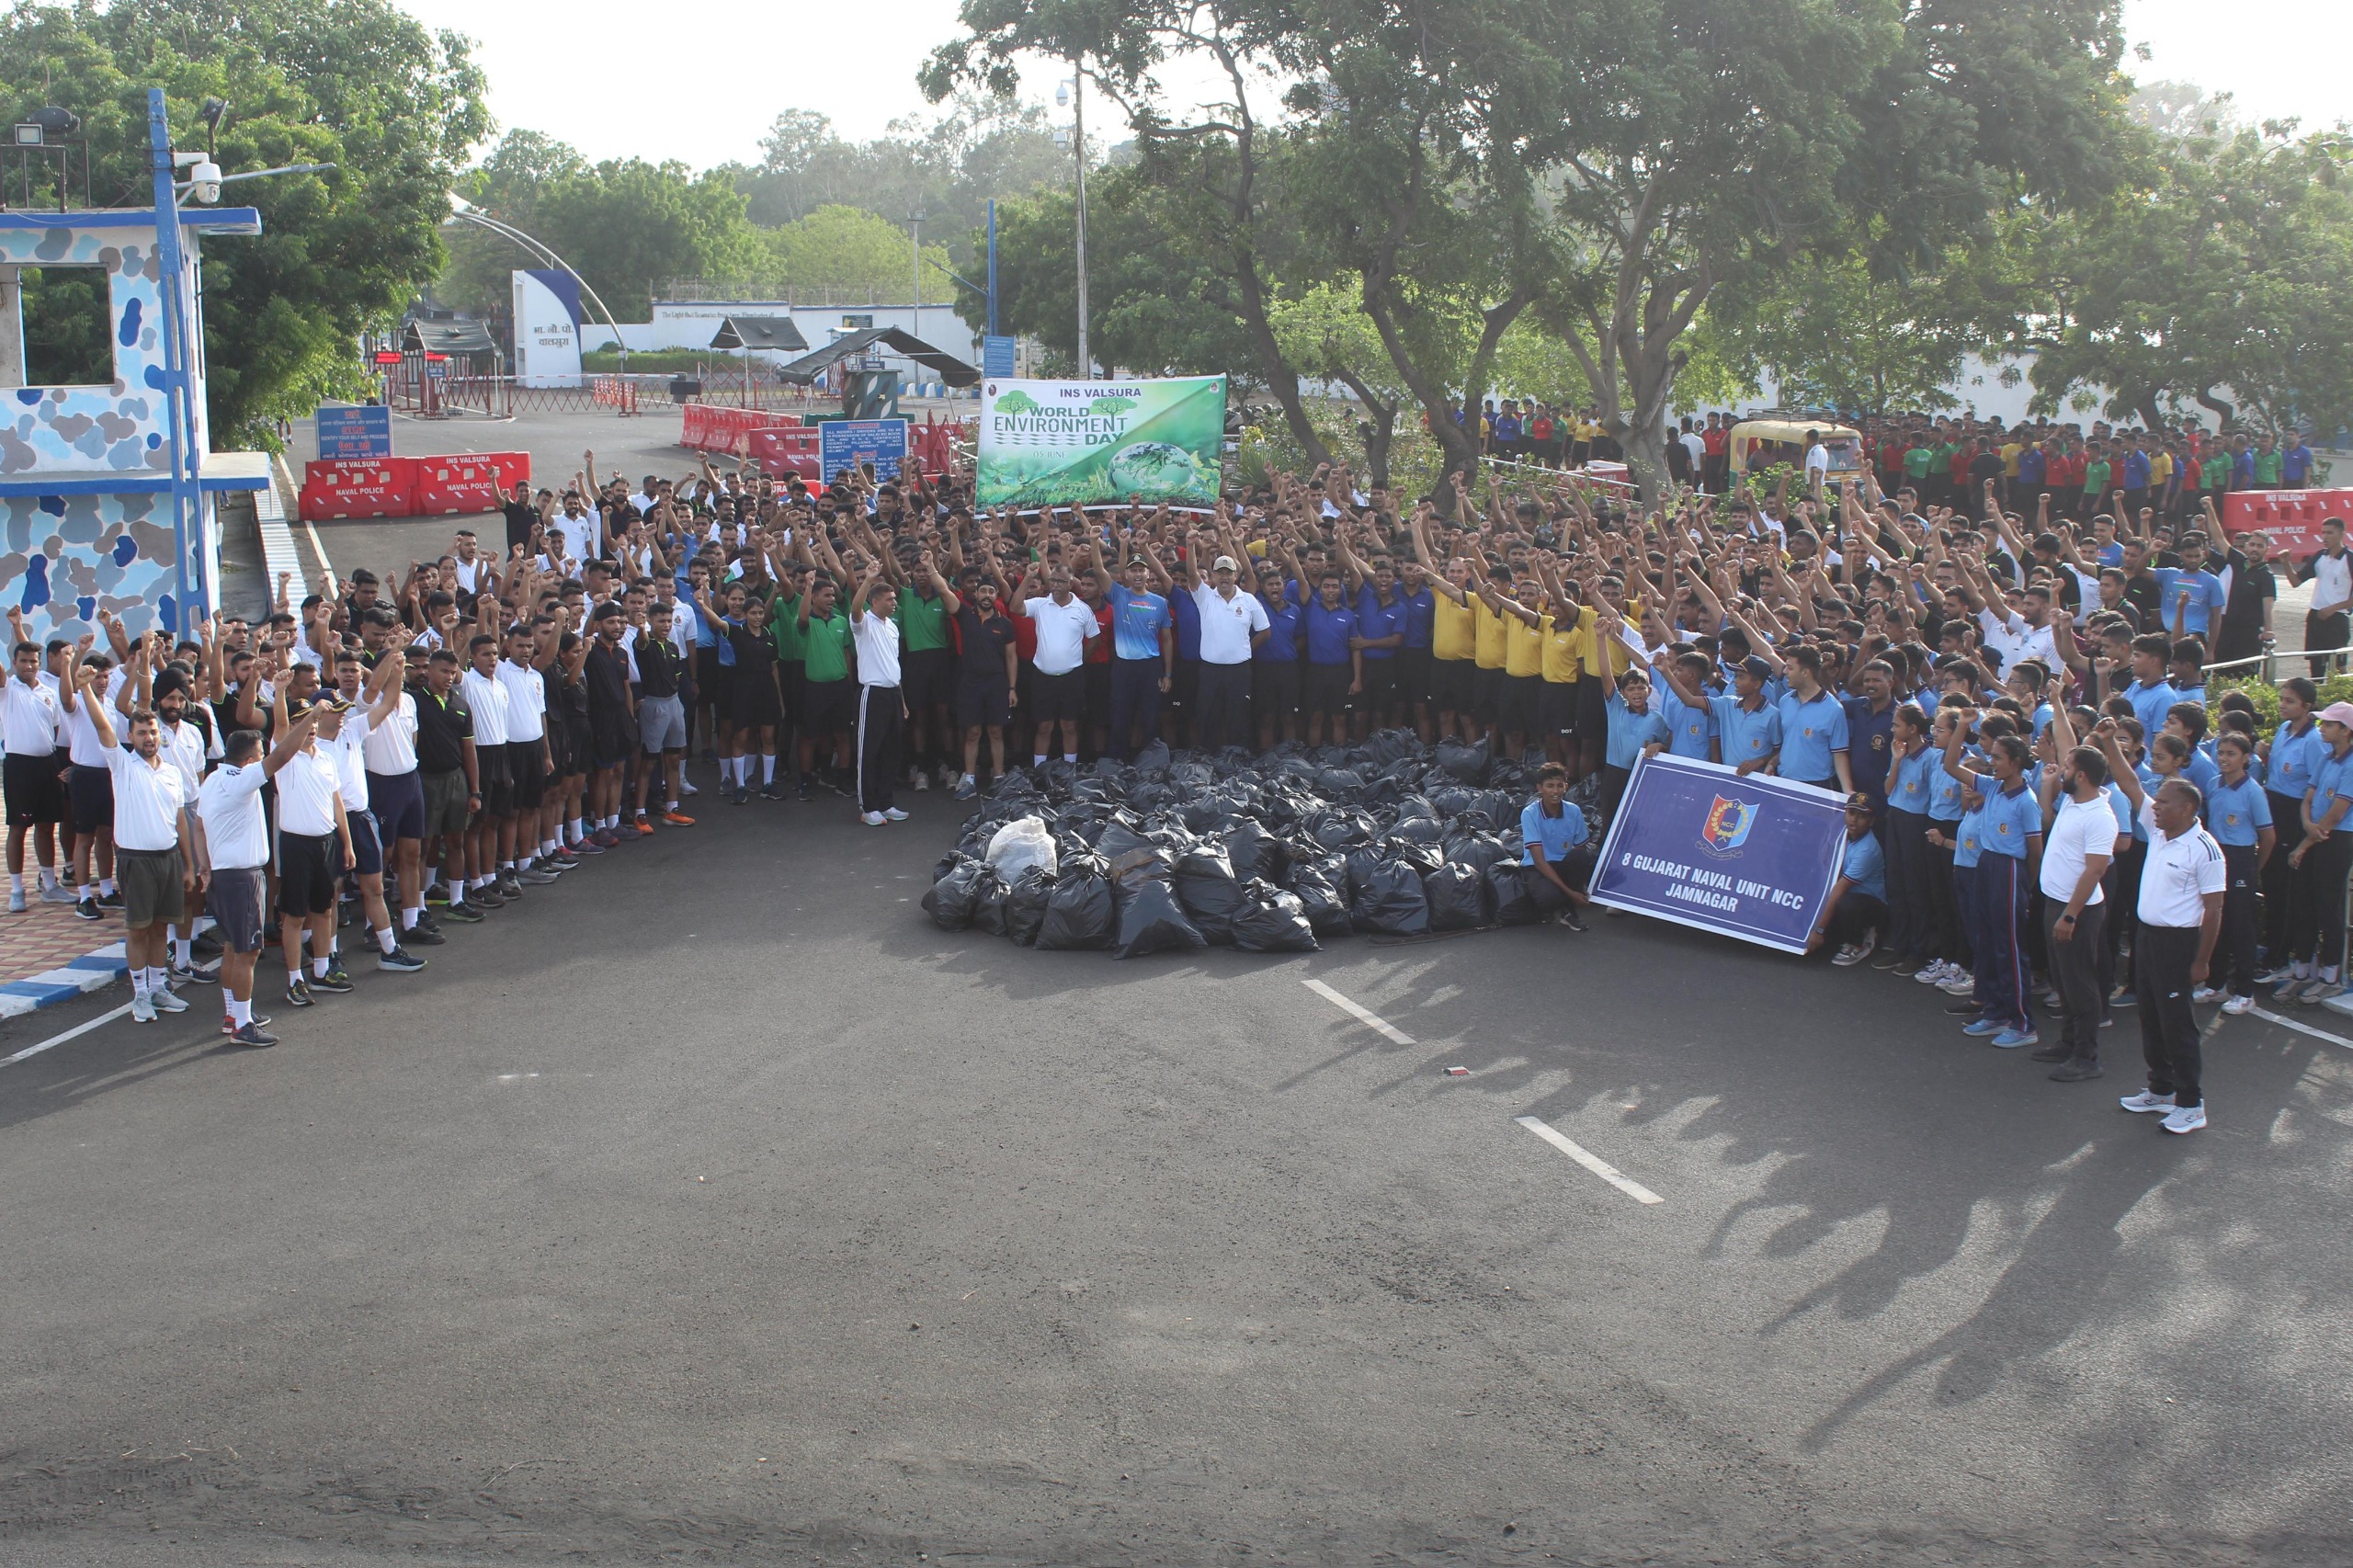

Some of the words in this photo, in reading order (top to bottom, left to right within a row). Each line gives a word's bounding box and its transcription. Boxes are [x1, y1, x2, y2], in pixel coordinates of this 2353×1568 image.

[1060, 389, 1080, 398] INS
[1084, 388, 1142, 398] VALSURA
[1029, 407, 1090, 417] WORLD
[994, 416, 1128, 433] ENVIRONMENT
[1085, 432, 1124, 446] DAY
[1621, 852, 1632, 866] 8
[1633, 854, 1691, 880] GUJARAT
[1691, 868, 1733, 891] NAVAL
[1735, 879, 1771, 900] UNIT
[1770, 888, 1804, 911] NCC
[1665, 883, 1739, 913] JAMNAGAR
